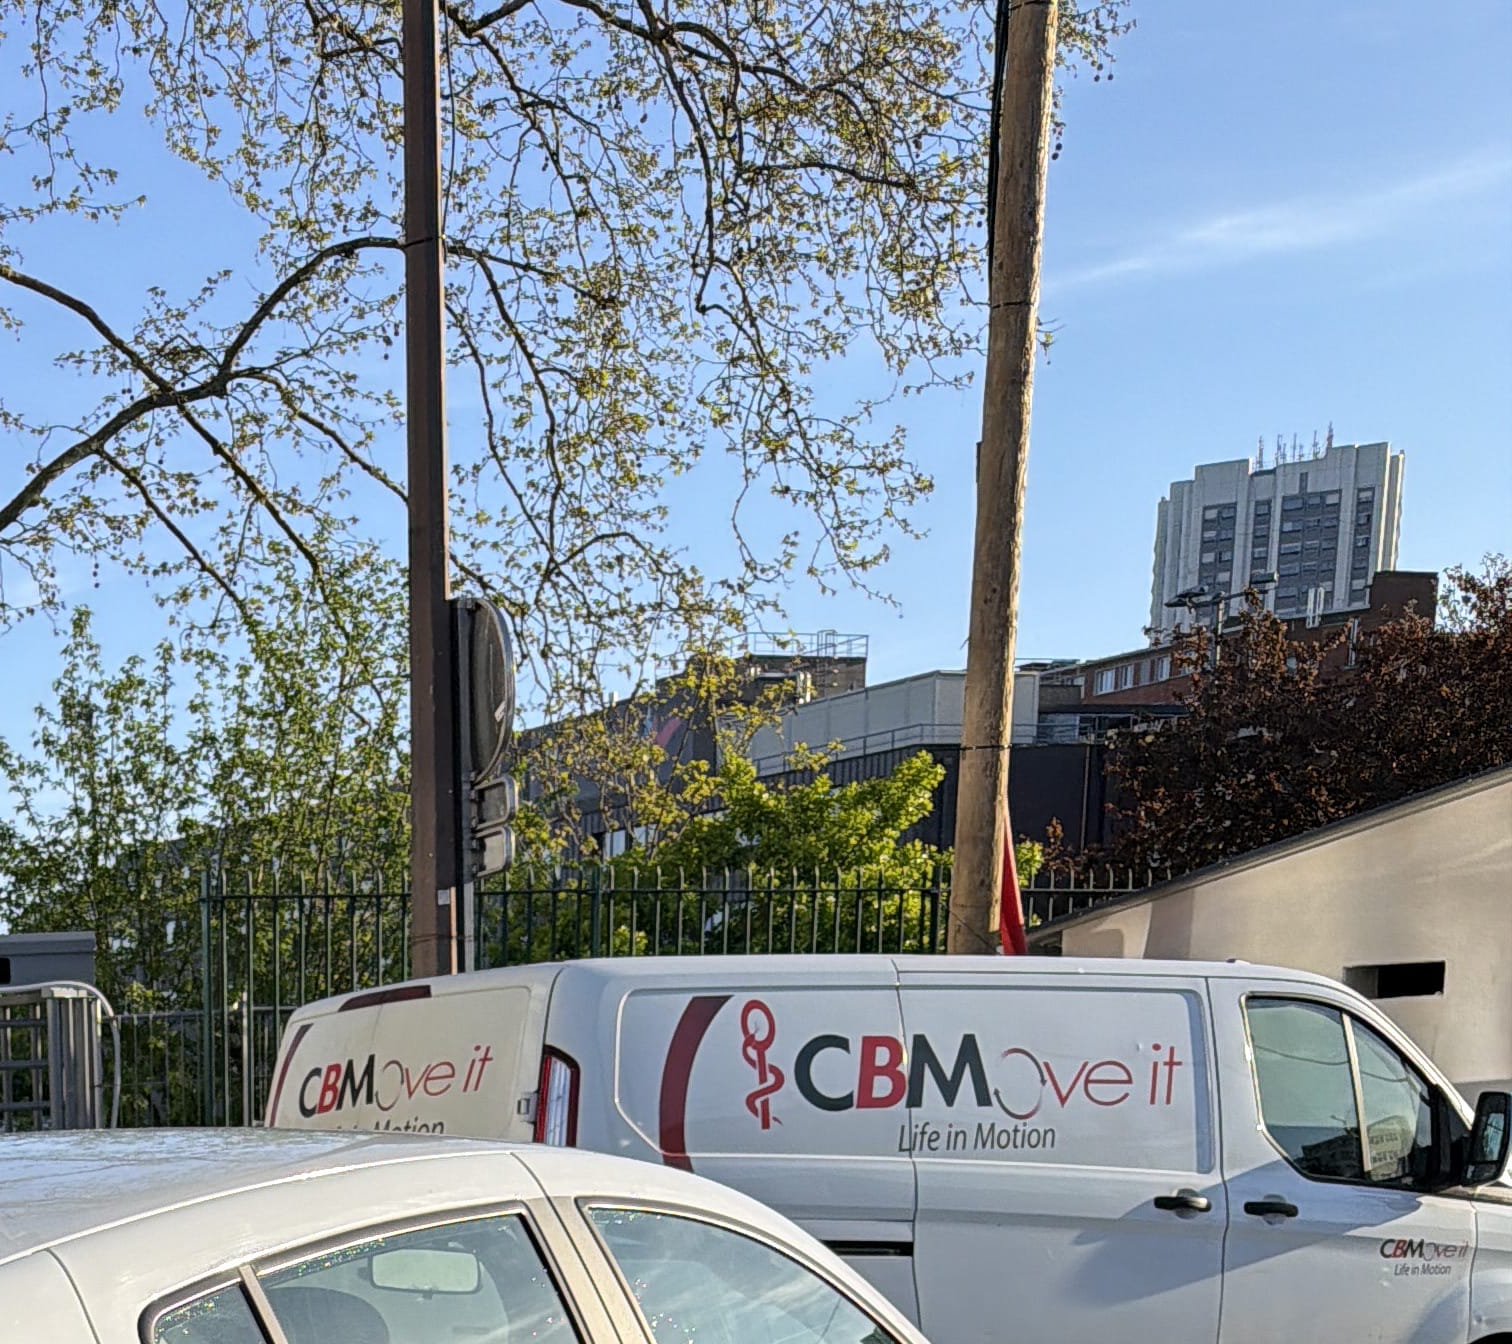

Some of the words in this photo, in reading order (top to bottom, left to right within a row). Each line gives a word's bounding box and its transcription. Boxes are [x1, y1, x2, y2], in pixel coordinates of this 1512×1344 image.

[1150, 1043, 1183, 1105] it
[898, 1122, 940, 1152] Life
[946, 1123, 967, 1151] in
[973, 1122, 1056, 1151] Motion
[1394, 1263, 1410, 1276] Life
[1411, 1264, 1420, 1275] in
[1421, 1263, 1452, 1275] Motion
